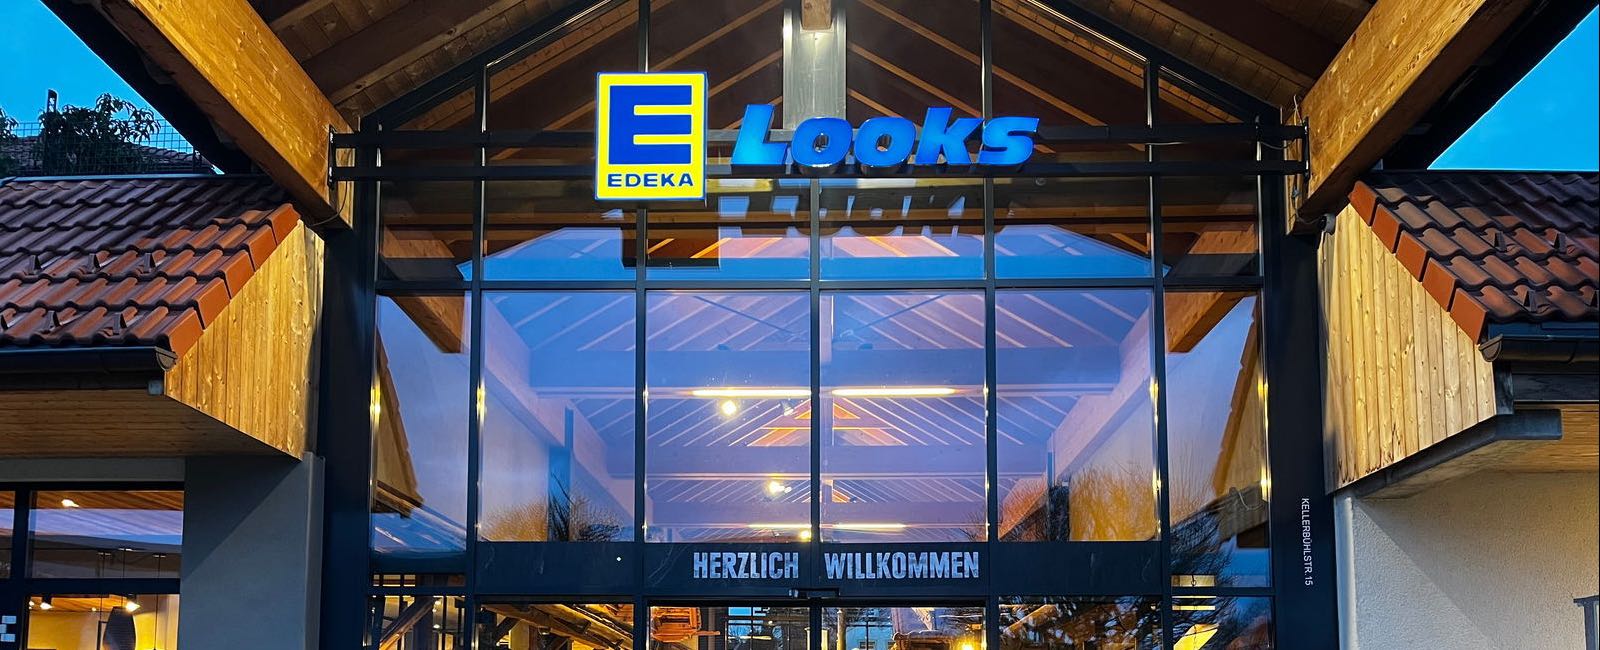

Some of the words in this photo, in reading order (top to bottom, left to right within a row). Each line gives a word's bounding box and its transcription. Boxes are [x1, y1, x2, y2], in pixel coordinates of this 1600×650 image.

[731, 103, 1040, 168] Looks
[607, 173, 694, 187] EDEKA
[693, 551, 798, 579] HERZLICH
[824, 551, 979, 580] WILLKOMMEN
